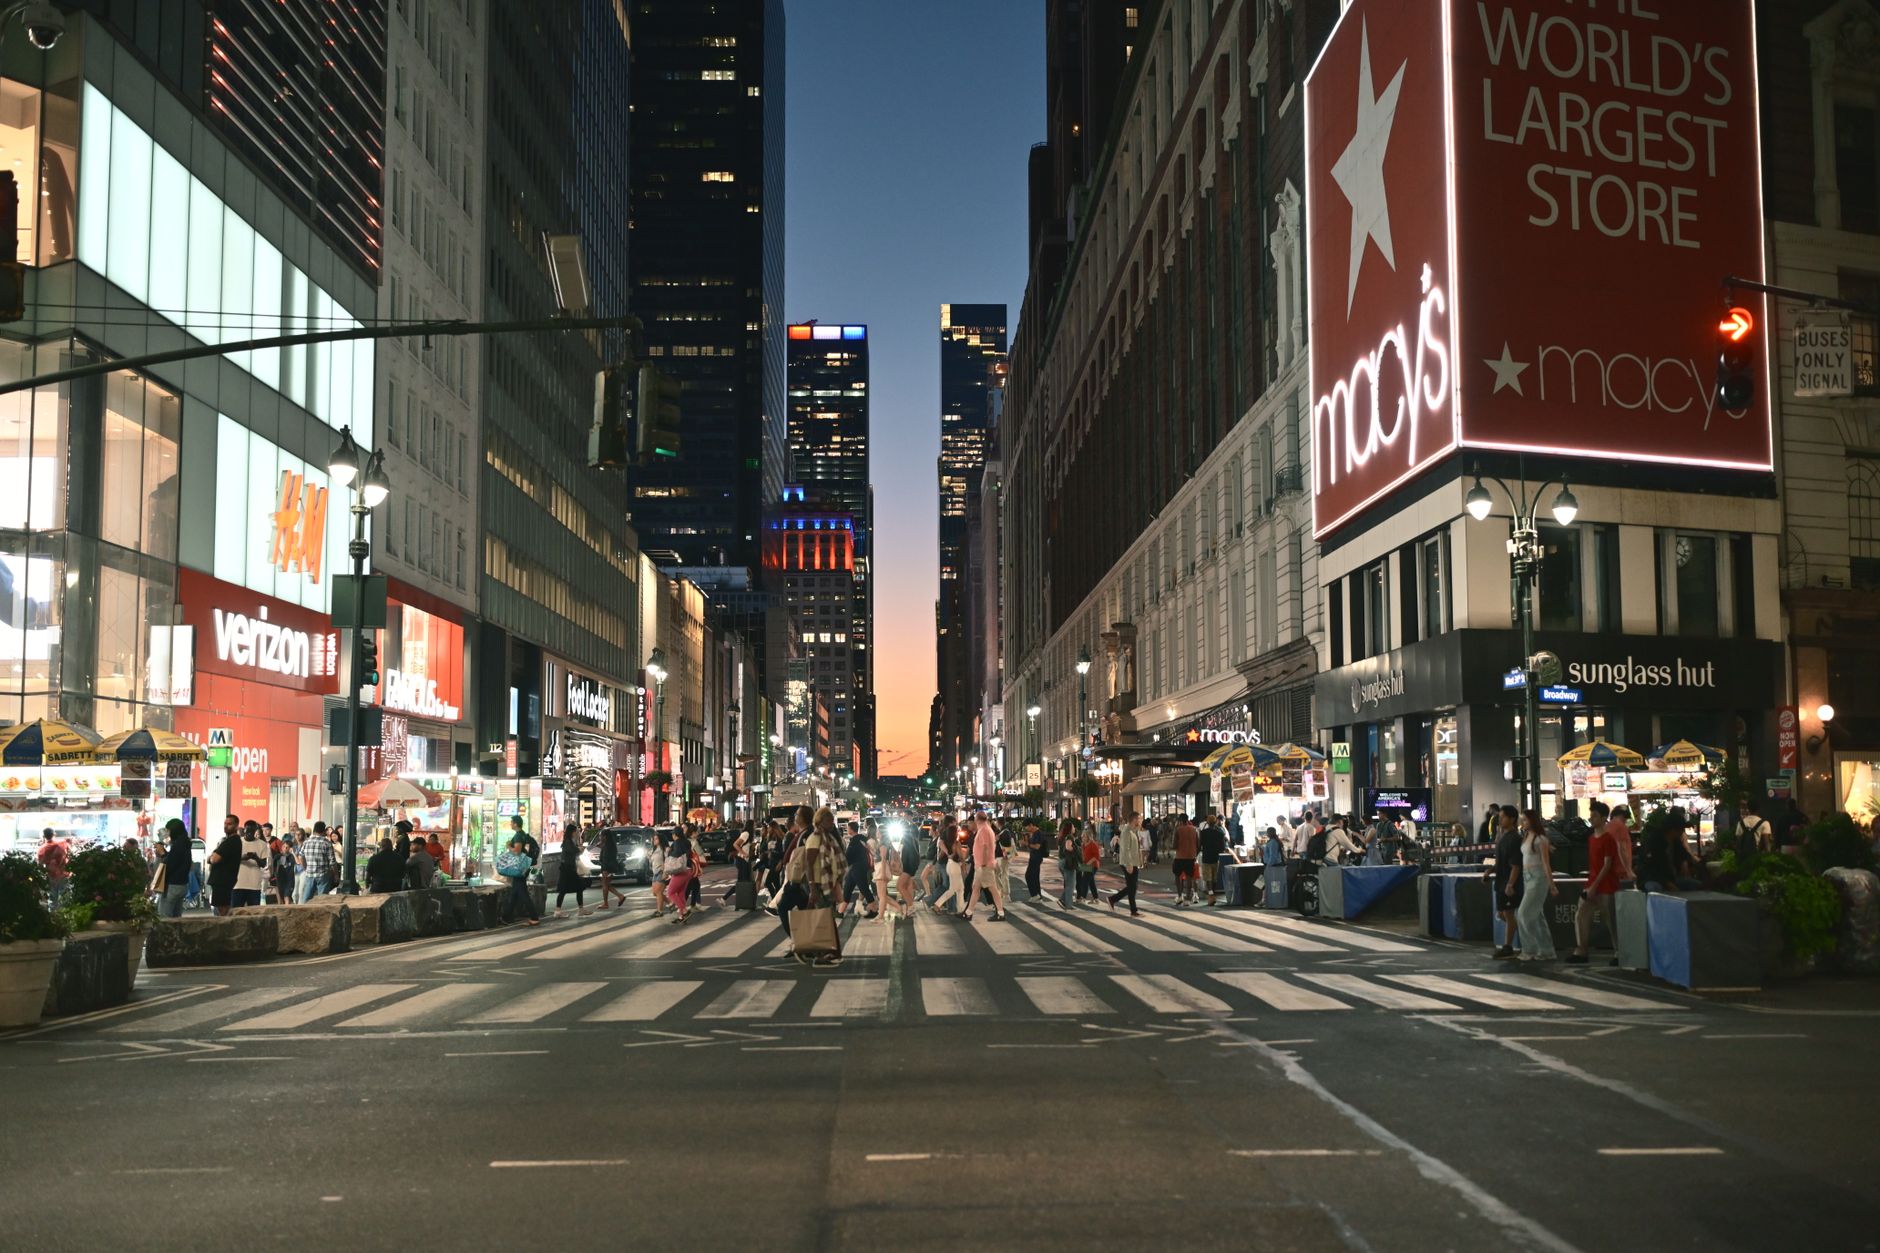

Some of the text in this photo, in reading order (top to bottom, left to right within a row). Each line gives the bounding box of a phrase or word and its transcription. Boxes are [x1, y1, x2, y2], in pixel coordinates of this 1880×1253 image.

[1477, 1, 1732, 105] WORLD'S
[1483, 77, 1728, 177] LARGEST
[1527, 163, 1701, 249] STORE
[1798, 330, 1849, 348] BUSES
[1803, 352, 1845, 368] ONLY
[1314, 262, 1449, 495] macy's
[1538, 345, 1748, 431] macy
[1799, 373, 1848, 390] SIGNAL
[267, 469, 329, 585] H&M
[213, 605, 309, 678] verizon
[326, 632, 338, 676] verizon
[1361, 669, 1405, 708] sunglass hut
[1568, 655, 1716, 693] sunglass hut
[568, 673, 609, 722] Foot Locker
[1543, 689, 1578, 702] Broadway
[1200, 728, 1261, 745] macy's
[1779, 740, 1796, 748] OPEN
[1780, 732, 1795, 740] NOW
[47, 750, 93, 762] SABRETT
[231, 746, 268, 780] open
[1666, 755, 1700, 764] SABRETT
[1555, 911, 1602, 924] SQUE
